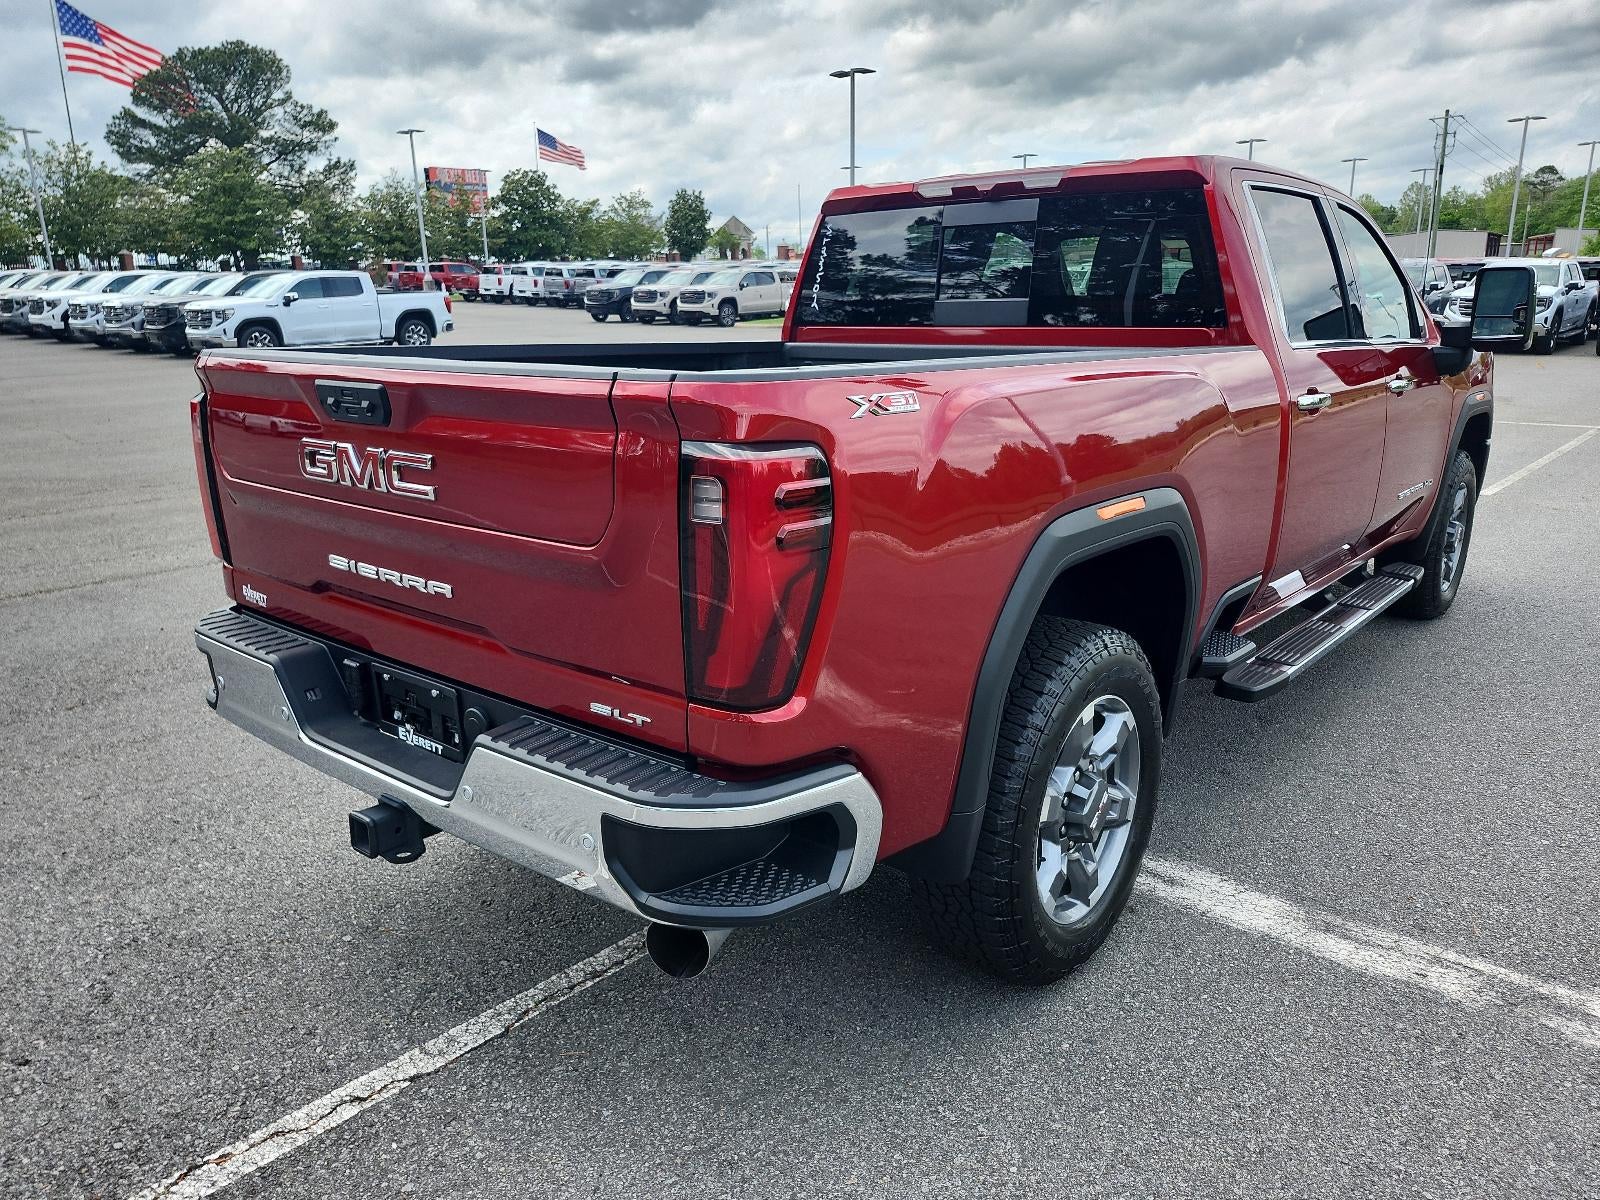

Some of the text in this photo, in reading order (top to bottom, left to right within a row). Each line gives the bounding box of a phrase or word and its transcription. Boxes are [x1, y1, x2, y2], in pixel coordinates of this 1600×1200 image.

[299, 437, 437, 501] GMC
[328, 554, 453, 599] SIERRA
[242, 583, 268, 604] EVERETT
[589, 702, 652, 727] SLT
[398, 725, 444, 755] EVERETT
